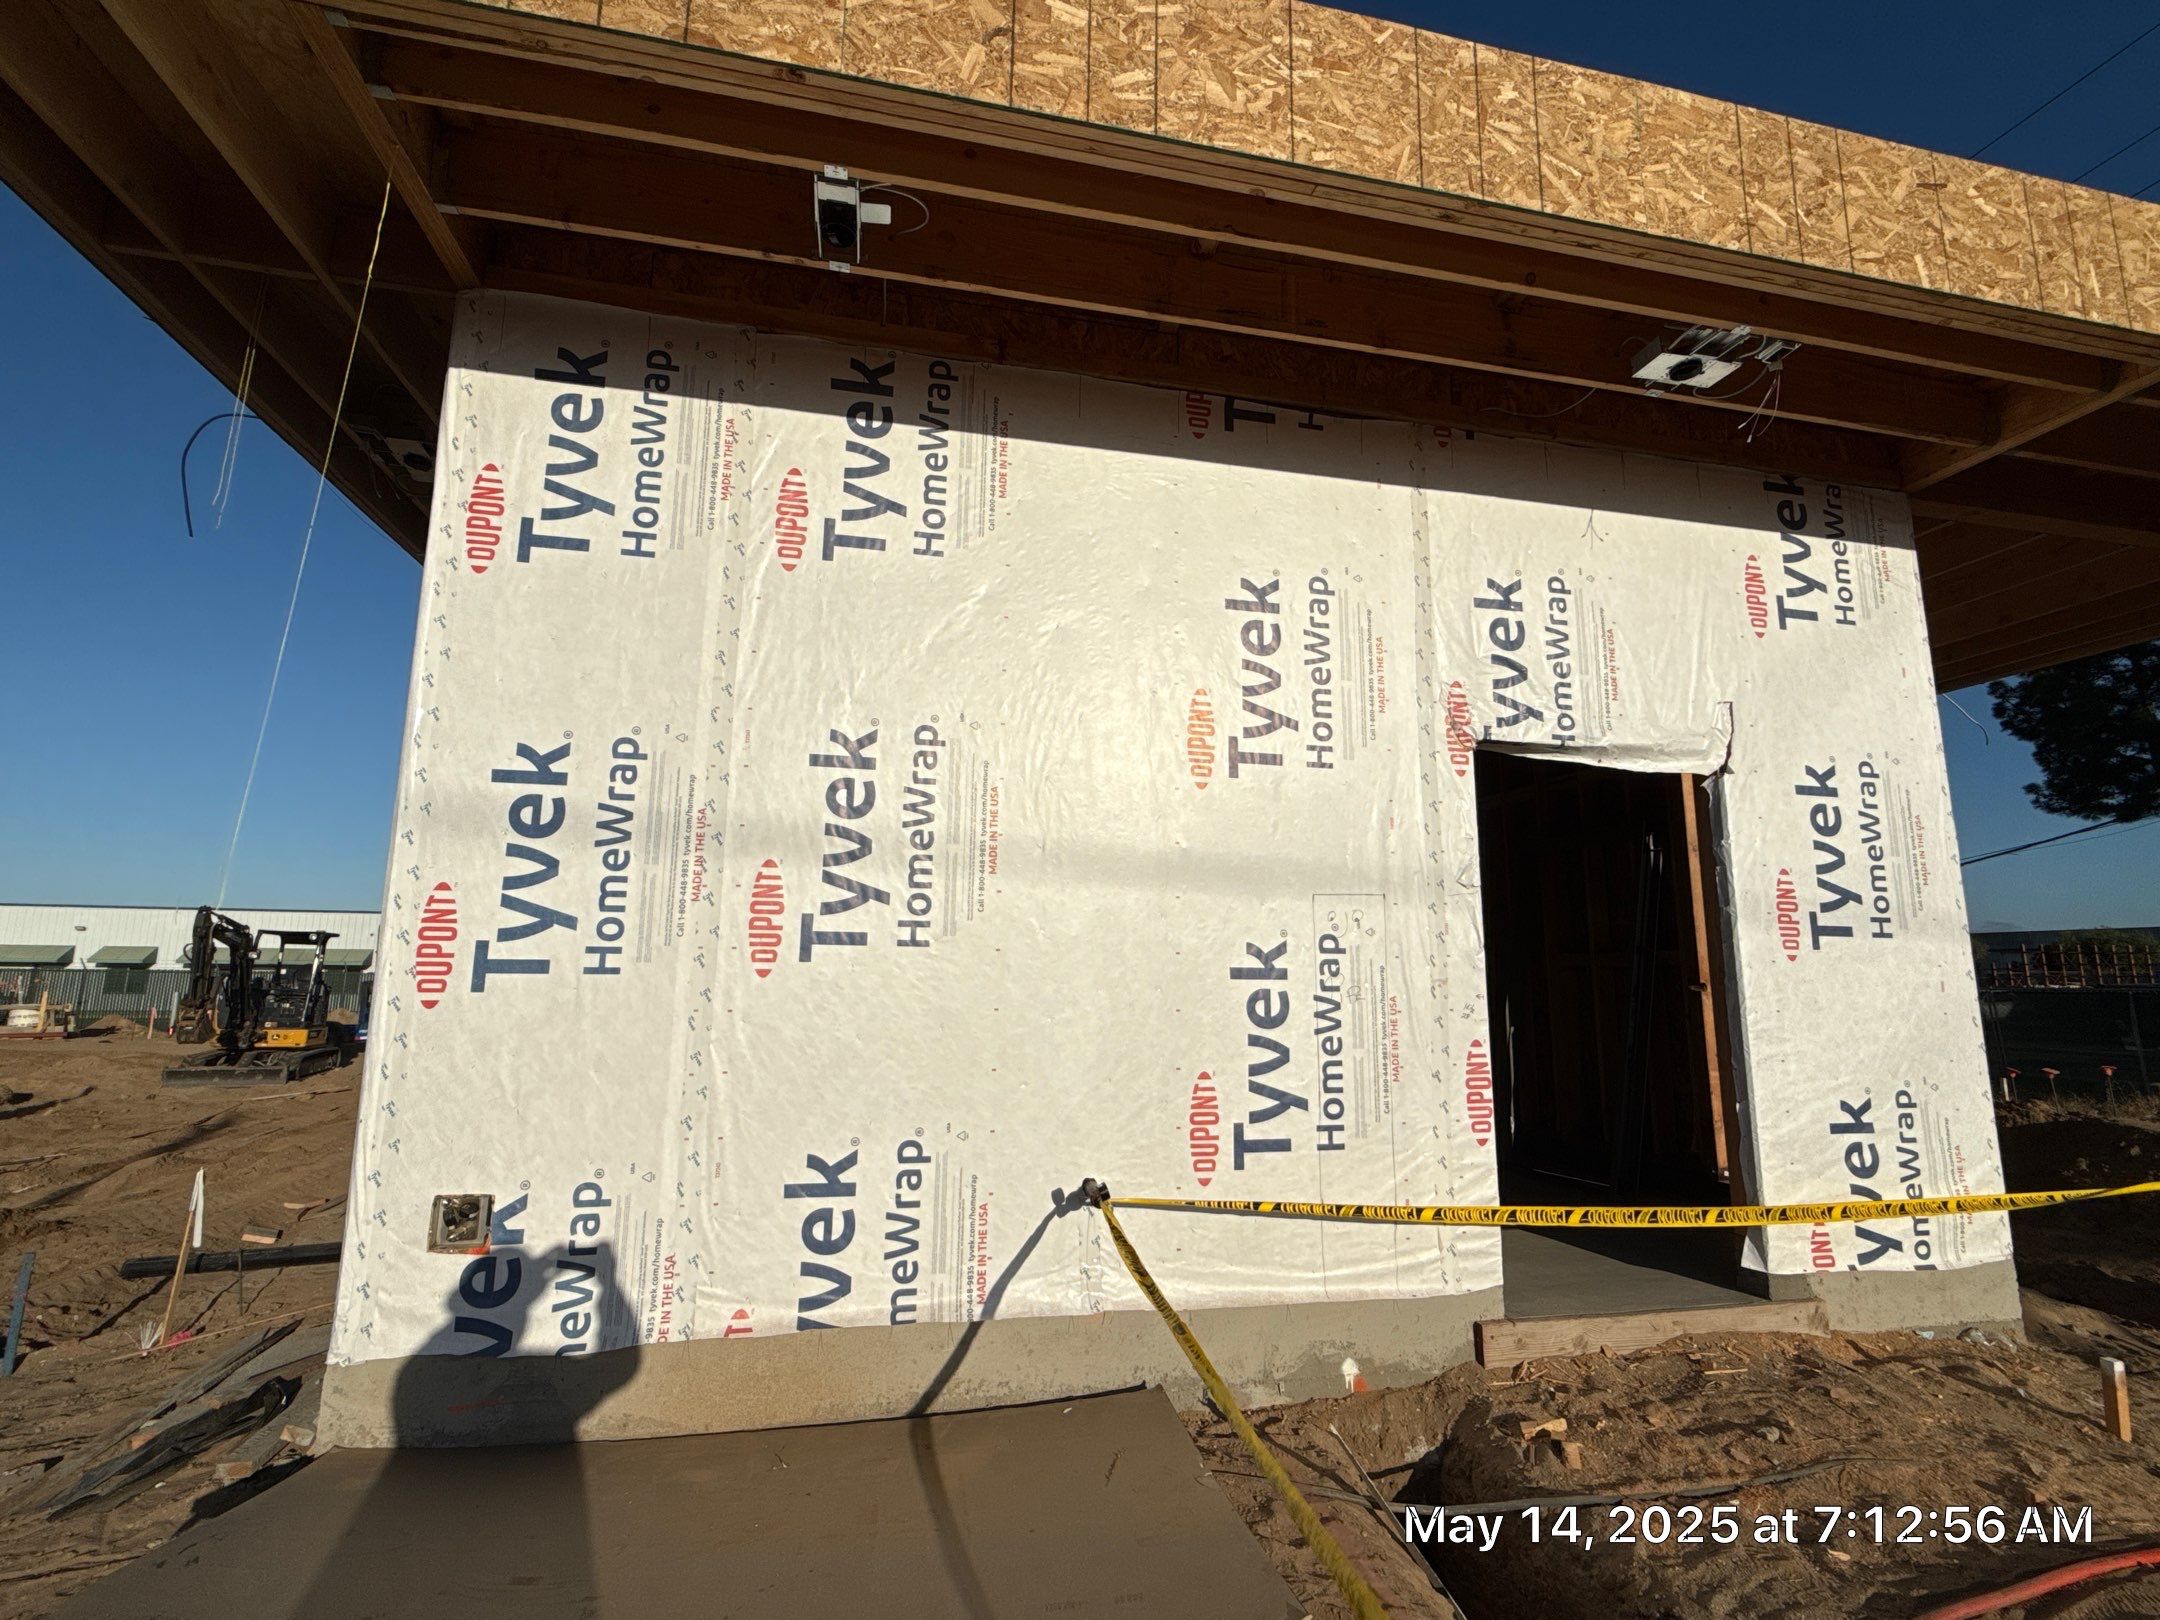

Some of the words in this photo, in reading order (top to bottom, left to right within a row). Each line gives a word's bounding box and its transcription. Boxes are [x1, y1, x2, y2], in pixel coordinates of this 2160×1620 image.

[1186, 393, 1212, 429] DUP
[714, 388, 725, 460] tyvek.com/homewrap
[727, 418, 736, 437] USA
[1000, 421, 1008, 438] USA
[725, 438, 735, 454] THE
[999, 441, 1008, 457] THE
[724, 460, 733, 470] IN
[999, 460, 1007, 469] IN
[709, 462, 720, 516] 1-800-448-9835
[721, 473, 732, 500] MADE
[998, 472, 1007, 498] MADE
[465, 474, 504, 562] DUPONT
[707, 517, 715, 531] Call
[777, 477, 809, 563] DUPONT
[1823, 485, 1856, 627] HomeWra
[1744, 563, 1767, 630] DUPONT
[1376, 656, 1384, 673] THE
[1610, 665, 1616, 674] IN
[1377, 675, 1384, 685] IN
[1187, 698, 1215, 778] DUPONT
[980, 761, 989, 836] tyvek.com/homewrap
[990, 786, 998, 806] USA
[683, 774, 696, 856] tyvek.com/homewrap
[697, 808, 707, 829] USA
[990, 809, 998, 828] THE
[695, 832, 705, 853] THE
[990, 831, 998, 841] IN
[694, 855, 703, 866] IN
[989, 844, 997, 874] MADE
[1919, 851, 1925, 859] IN
[1920, 861, 1928, 885] MADE
[678, 859, 689, 921] 1-800-448-9835
[691, 870, 702, 902] MADE
[749, 869, 785, 967] DUPONT
[1775, 878, 1800, 951] DUPONT
[677, 922, 685, 937] Call
[415, 891, 458, 995] DUPONT
[1389, 996, 1397, 1015] USA
[1391, 1039, 1399, 1050] IN
[1392, 1053, 1400, 1082] MADE
[1466, 1050, 1493, 1138] DUPONT
[1190, 1083, 1219, 1175] DUPONT
[1958, 1167, 1966, 1183] THE
[969, 1175, 978, 1262] tyvek.com/homewrap
[979, 1203, 988, 1225] USA
[1362, 1206, 1417, 1219] CAUTION
[1441, 1208, 1492, 1221] CUIDADO
[1517, 1209, 1566, 1223] CAUTION
[1588, 1210, 1635, 1224] CUIDADO
[1658, 1209, 1703, 1223] CAUTION
[1724, 1209, 1766, 1222] CUIDADO
[1787, 1207, 1829, 1221] CAUTION
[978, 1229, 987, 1252] THE
[1810, 1230, 1836, 1269] ONT
[649, 1218, 664, 1313] tyvek.com/homewrap
[663, 1254, 675, 1280] USA
[978, 1255, 987, 1266] IN
[661, 1284, 674, 1308] THE
[967, 1266, 975, 1322] 800-448-9835
[977, 1270, 986, 1304] MADE
[660, 1311, 671, 1324] IN
[657, 1328, 669, 1343] DE
